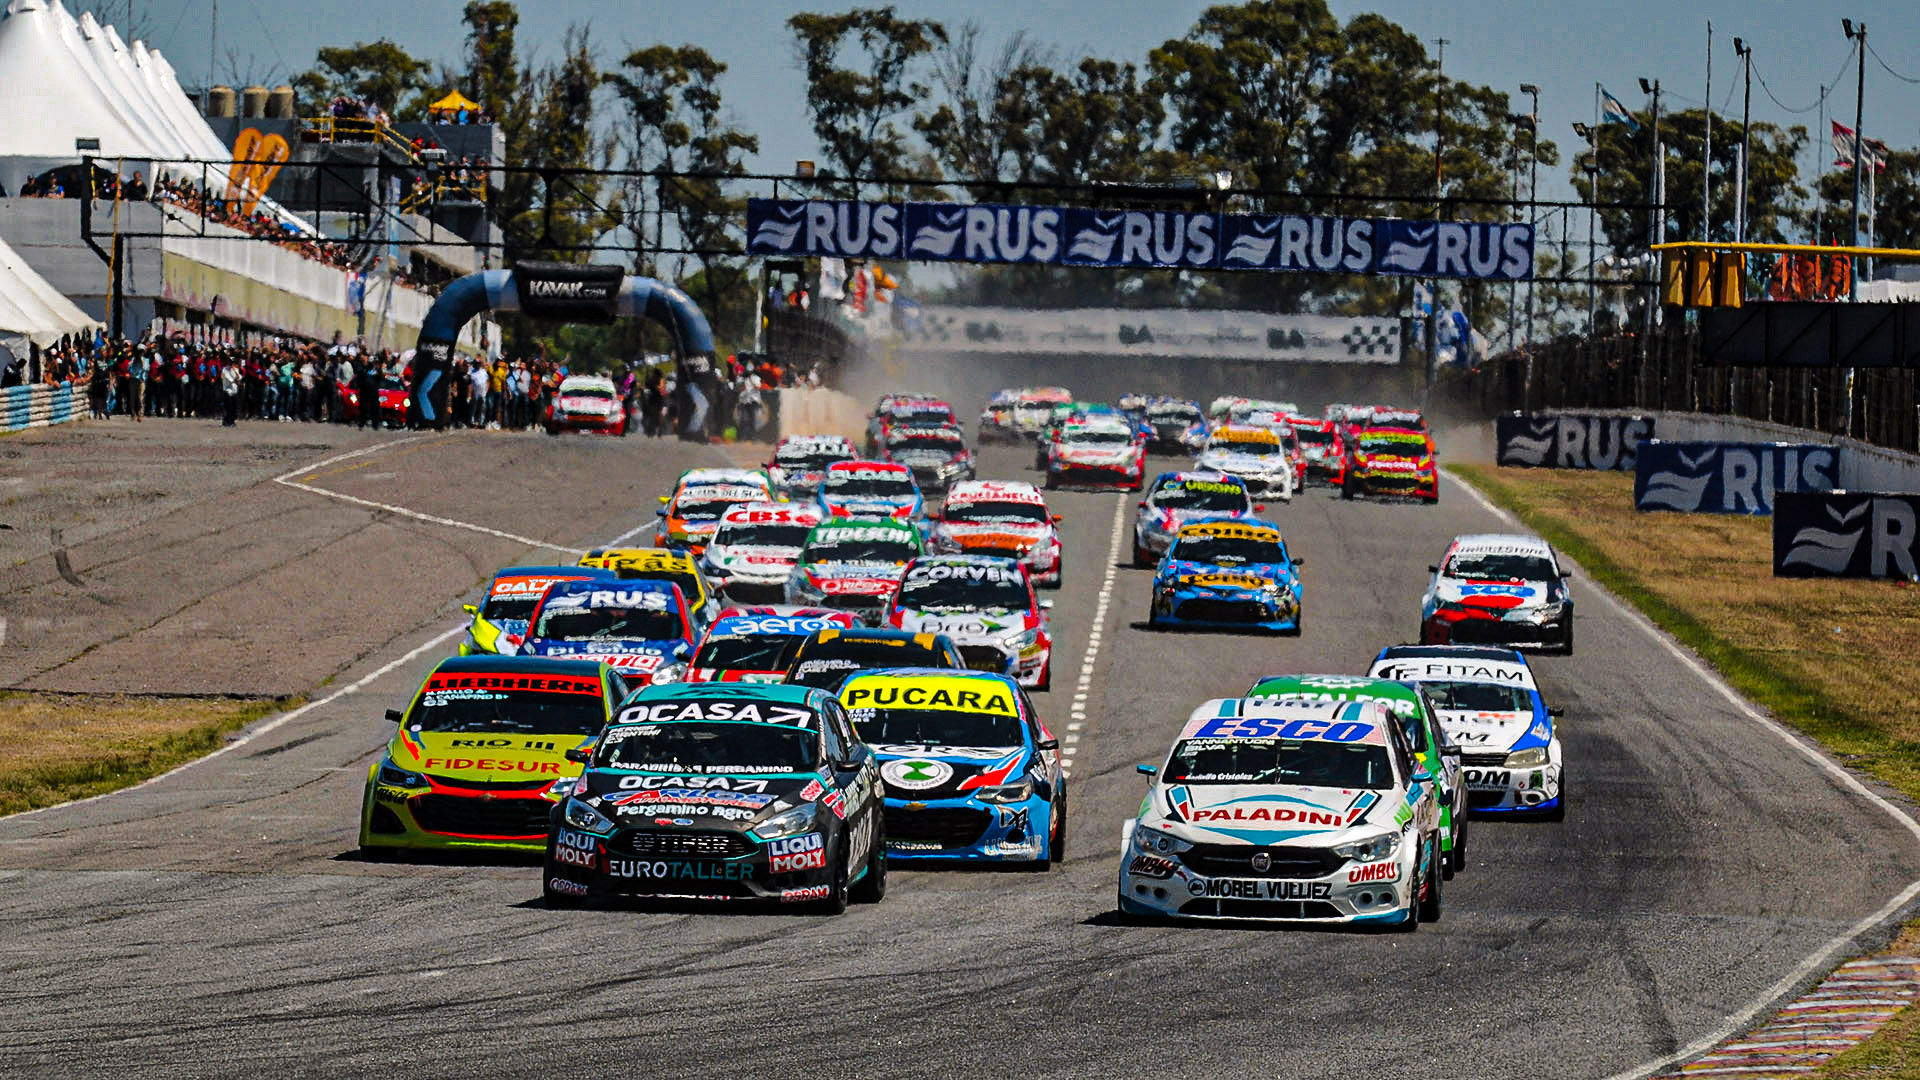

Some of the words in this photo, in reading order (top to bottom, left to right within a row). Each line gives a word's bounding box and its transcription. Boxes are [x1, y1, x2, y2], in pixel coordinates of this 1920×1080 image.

[806, 202, 899, 257] RUS
[965, 207, 1060, 263] RUS
[1123, 212, 1215, 266] RUS
[1281, 216, 1373, 271] RUS
[1437, 222, 1531, 280] RUS
[1558, 417, 1650, 470] RUS
[1722, 447, 1834, 512] RUS
[816, 527, 913, 544] TEDESCHI
[907, 565, 1024, 588] CORVEN
[590, 590, 668, 611] RUS
[1426, 664, 1523, 682] FITAM
[428, 678, 598, 693] LIEBHERR
[847, 688, 1010, 713] PUCARA
[618, 702, 763, 724] OCASA
[1194, 718, 1374, 742] ESCO
[451, 739, 512, 748] RIO
[525, 741, 555, 750] III
[424, 758, 561, 774] FIDESUR
[706, 765, 794, 774] PERGAMINO
[618, 776, 731, 790] OCASA
[616, 804, 709, 817] Pergamino
[711, 805, 756, 821] Agro
[1192, 808, 1342, 827] PALADINI
[558, 828, 596, 851] LIQUI
[771, 834, 823, 856] LIQUI
[556, 845, 595, 865] MOLY
[773, 850, 824, 872] MOLY
[609, 860, 755, 880] EUROTALLER
[1348, 862, 1396, 884] OMBU
[1206, 879, 1263, 899] MOREL
[1266, 882, 1333, 901] VULLIEZ
